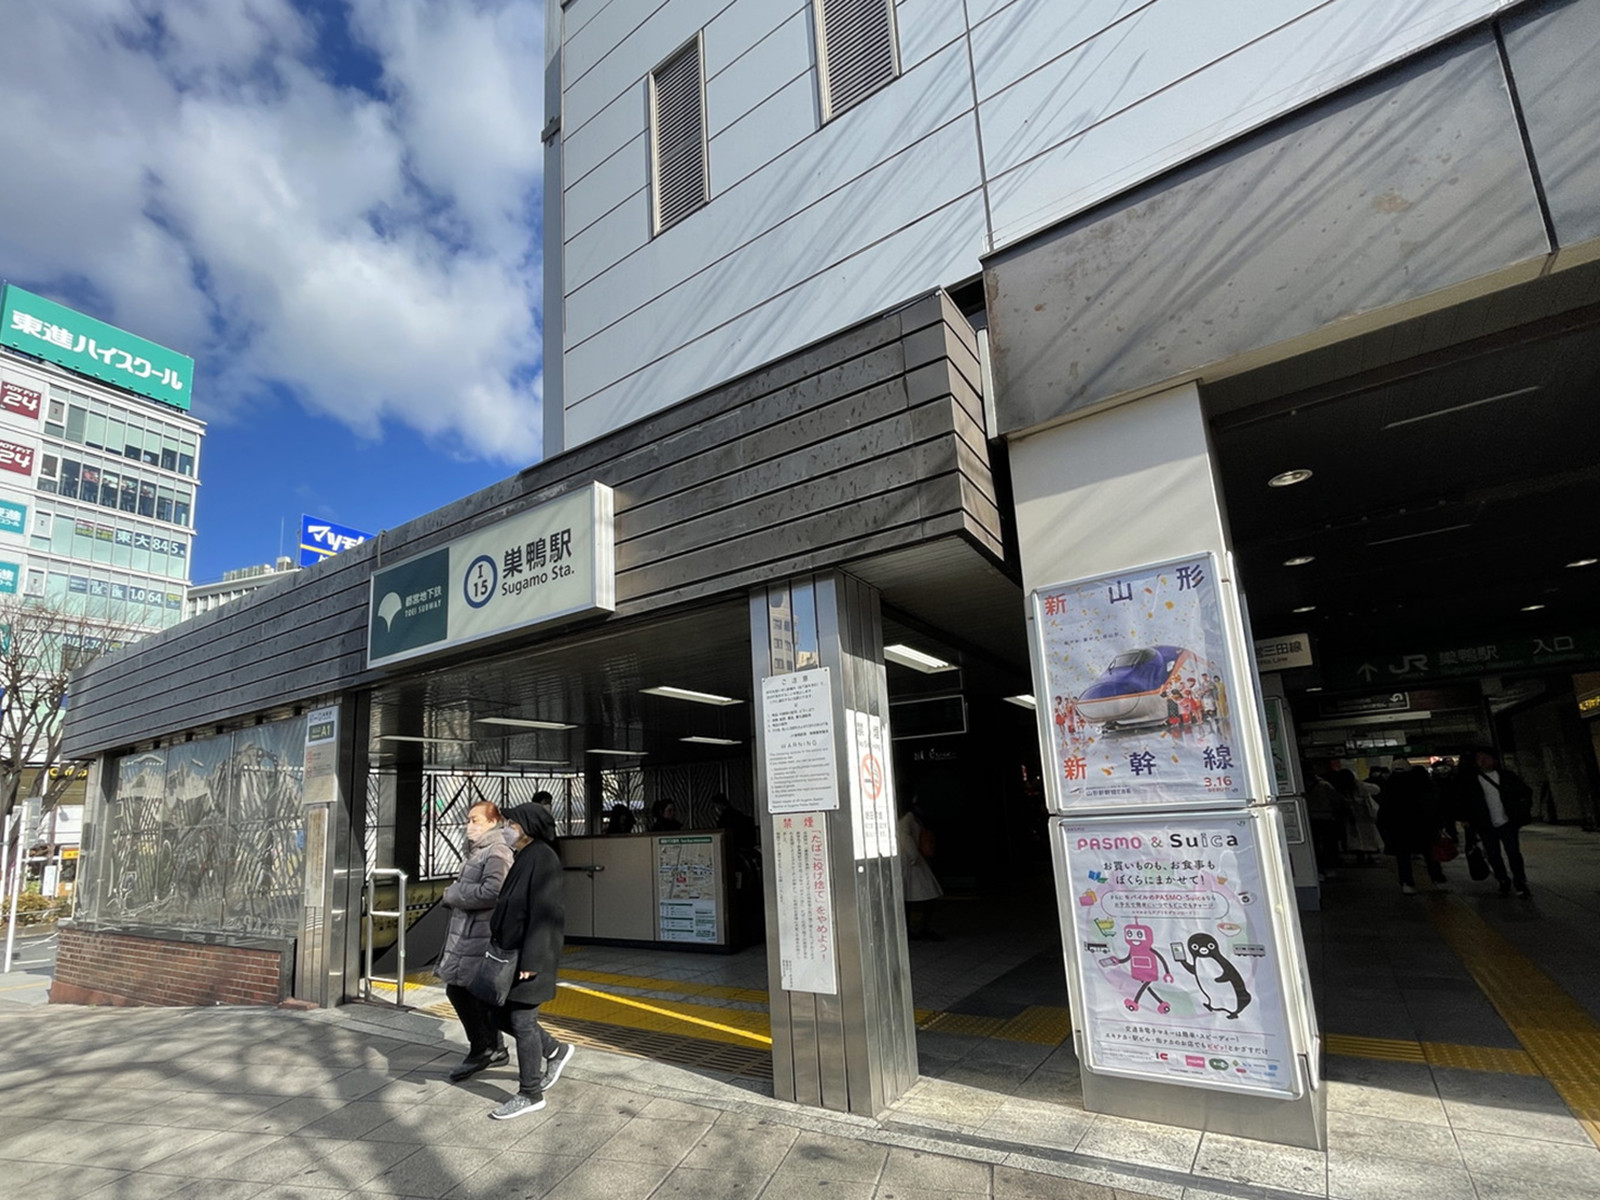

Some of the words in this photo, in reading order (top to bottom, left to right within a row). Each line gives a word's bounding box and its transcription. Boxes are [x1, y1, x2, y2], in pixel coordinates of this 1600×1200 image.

[10, 309, 184, 391] 東進ハイスクール
[3, 391, 38, 411] 24
[502, 528, 573, 579] 巣鴨駅
[477, 564, 484, 579] I
[501, 572, 548, 597] Sugamo
[551, 563, 576, 580] Sta.
[473, 579, 489, 598] 15
[1532, 635, 1575, 655] 入口
[1388, 653, 1430, 675] JR
[1203, 775, 1233, 788] 3.16
[783, 816, 814, 830] 禁煙
[1077, 836, 1143, 850] PASMO
[1150, 836, 1164, 849] &
[1170, 833, 1239, 849] Suica
